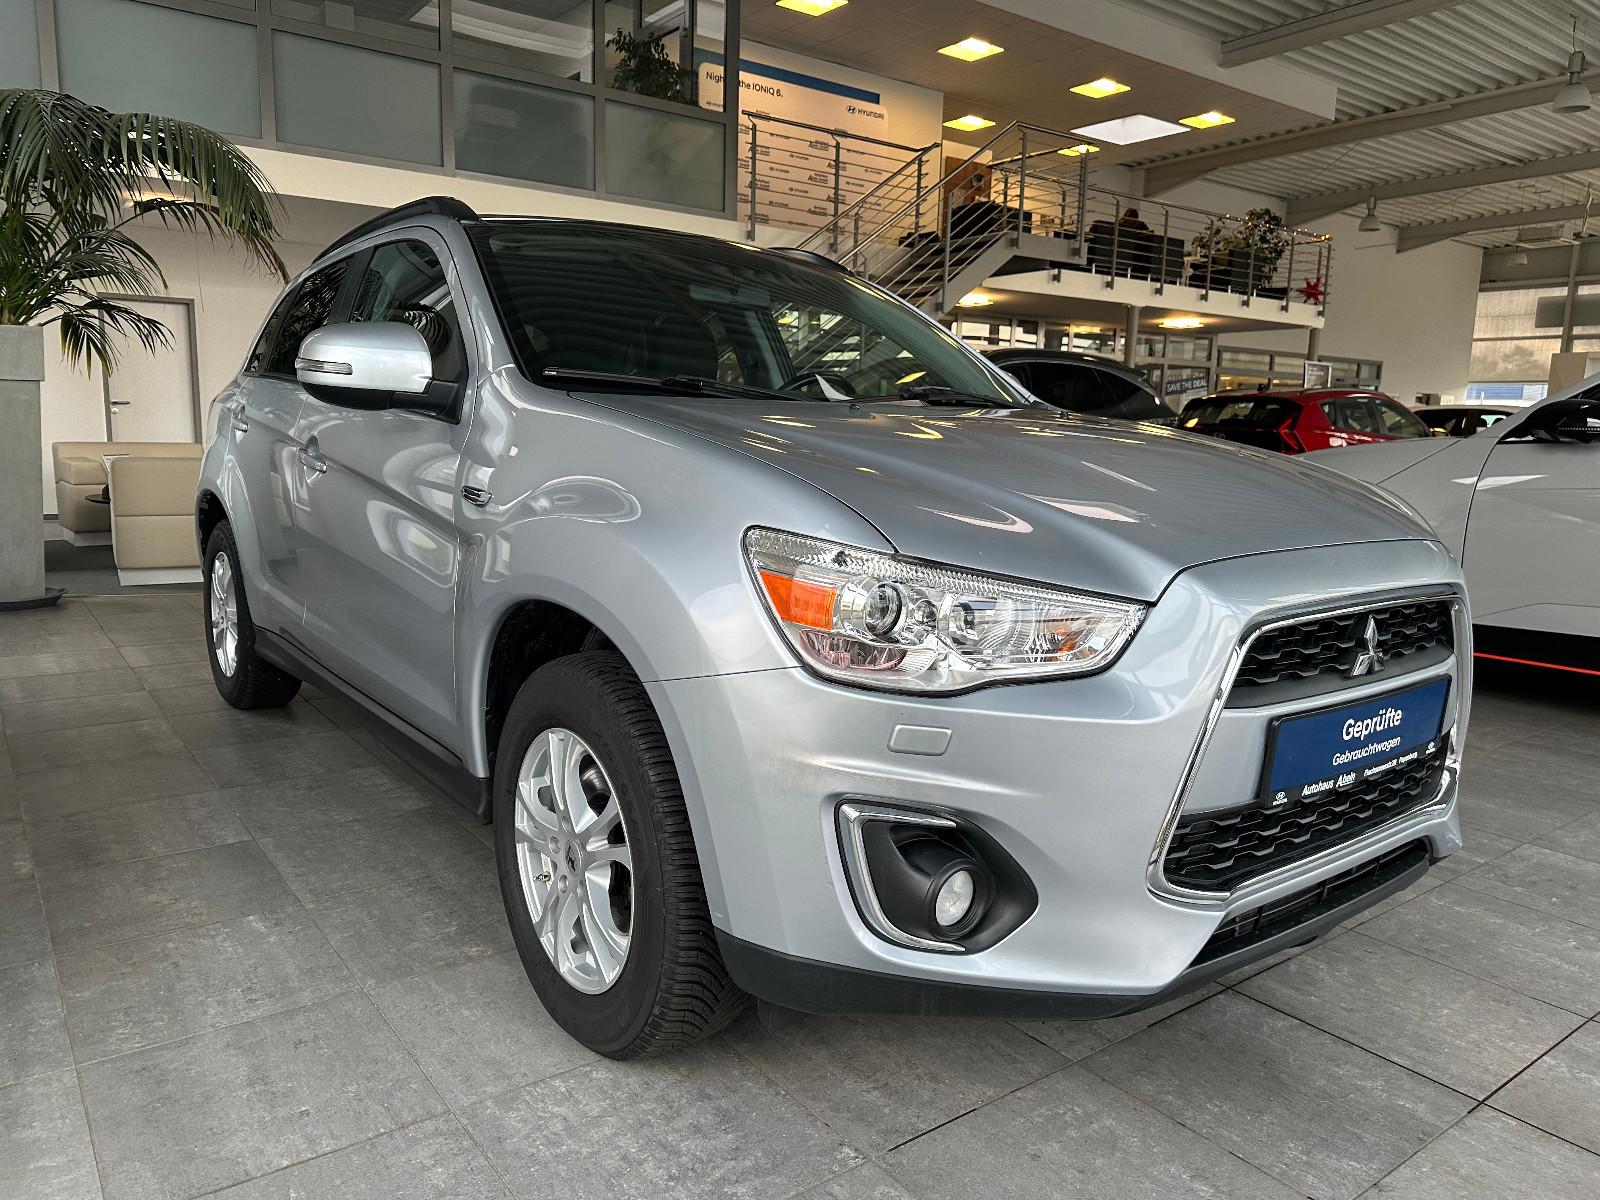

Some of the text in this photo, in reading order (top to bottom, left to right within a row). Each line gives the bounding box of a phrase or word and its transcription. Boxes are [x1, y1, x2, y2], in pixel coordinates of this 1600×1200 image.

[705, 71, 784, 98] Nigh the IONIQ 6.
[857, 108, 885, 120] HYUNDAI
[1166, 379, 1208, 393] SAVE THE DEAL
[1342, 707, 1402, 740] Geprüfte
[1332, 736, 1401, 766] Gebrauchtwagen
[1301, 780, 1335, 797] Autohaus
